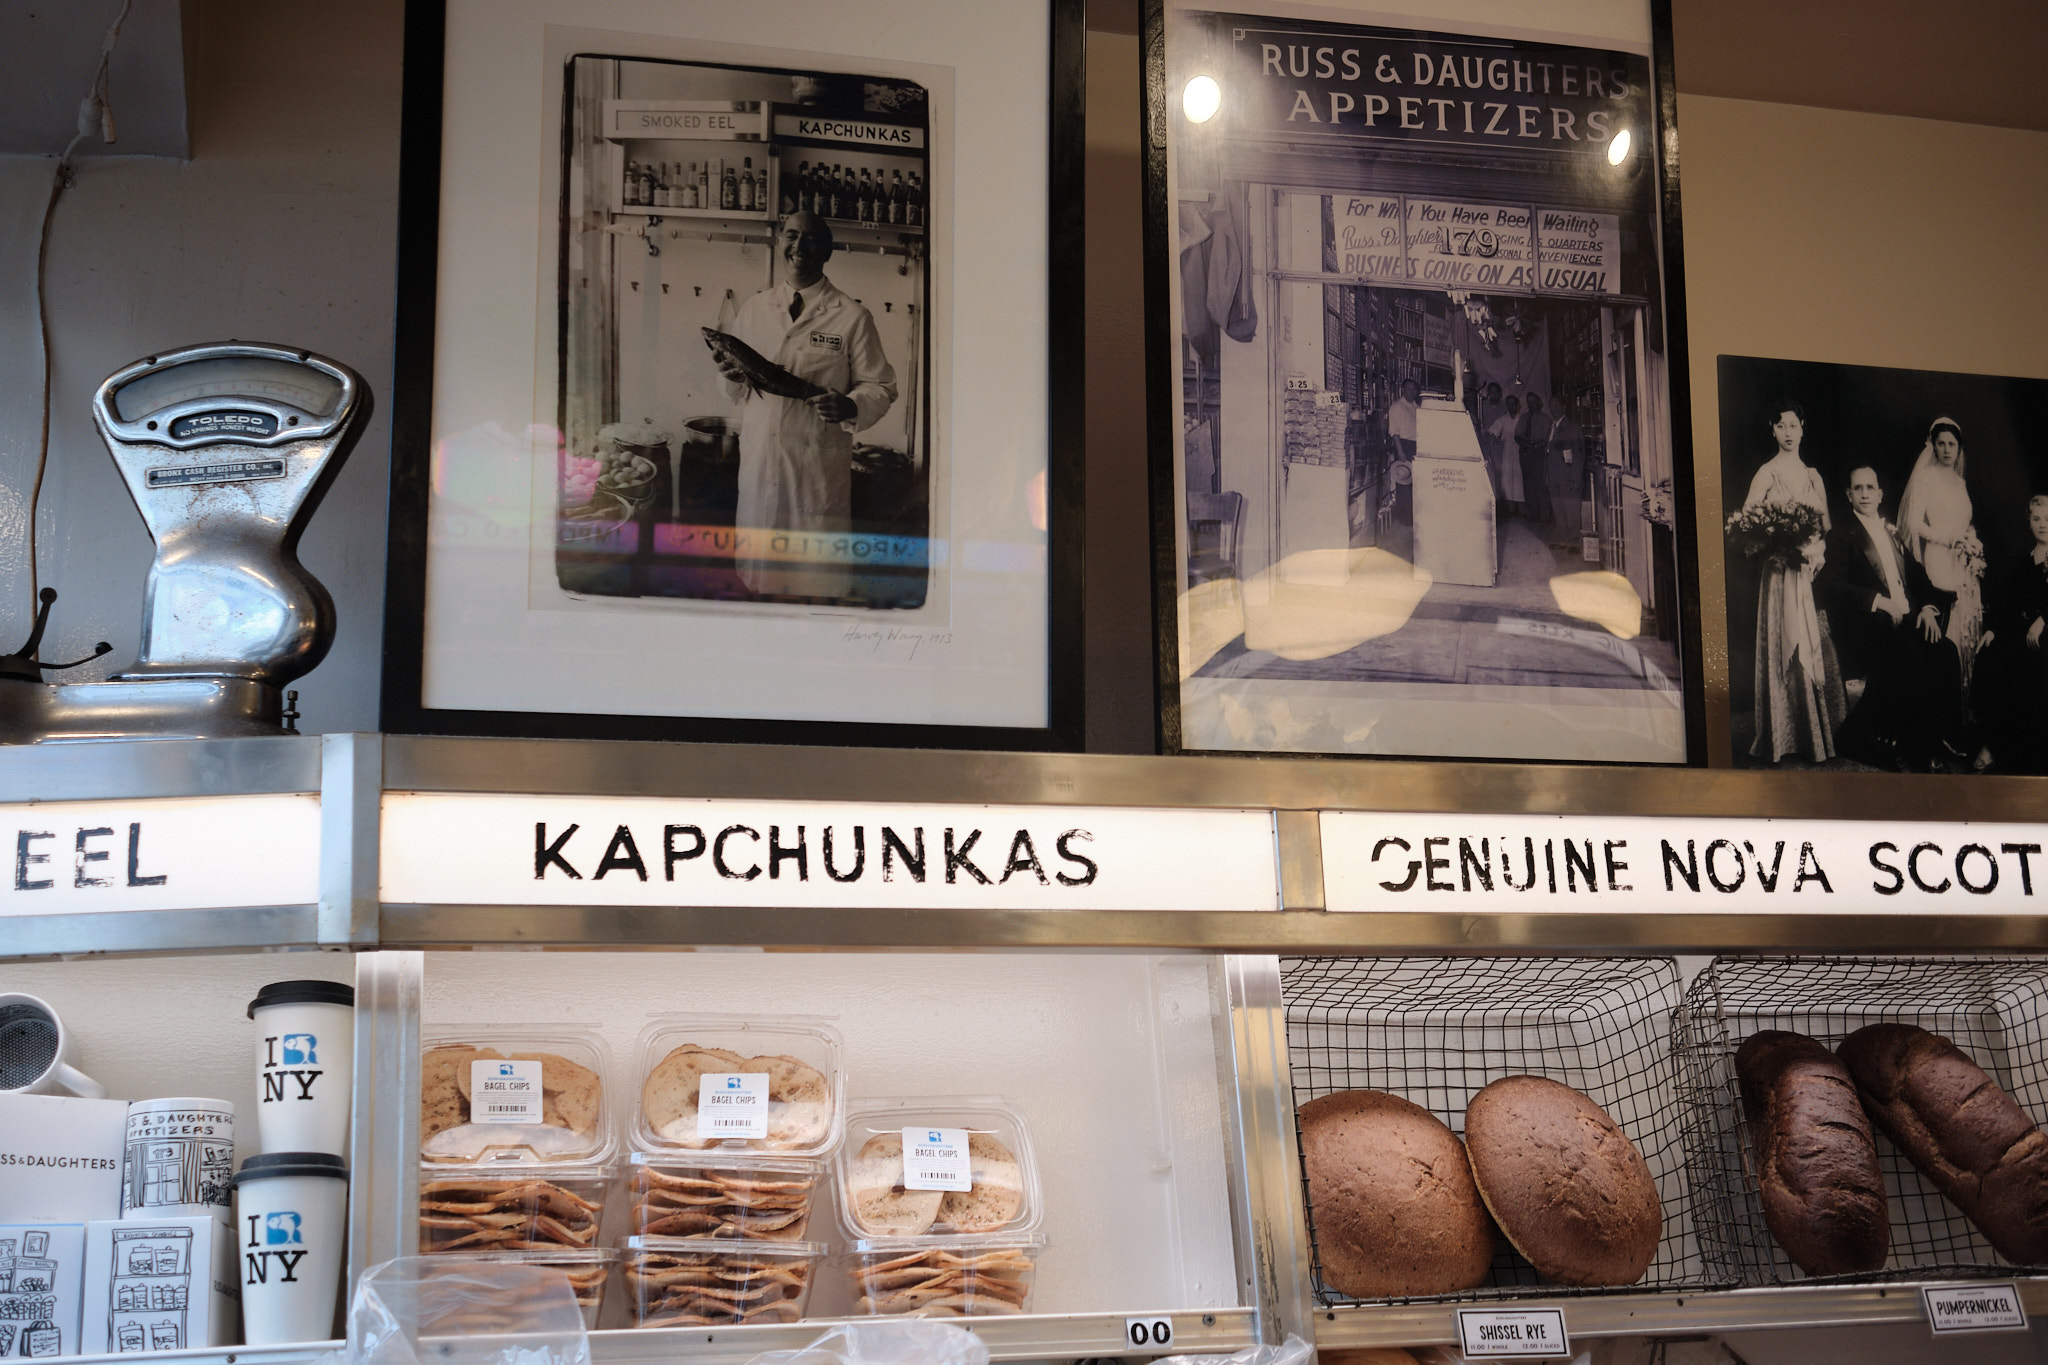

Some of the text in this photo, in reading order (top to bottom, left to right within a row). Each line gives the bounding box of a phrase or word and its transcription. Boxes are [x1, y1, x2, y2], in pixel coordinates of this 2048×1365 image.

[1261, 43, 1630, 100] RUSS & DAUGHTERS
[641, 115, 735, 129] SMOKED EEL
[1286, 90, 1611, 143] APPETIZERS
[799, 120, 911, 143] KAPCHUNKAS
[1347, 199, 1374, 216] For
[1378, 202, 1413, 219] Wht
[1420, 204, 1446, 221] You
[1452, 207, 1489, 226] Have
[1543, 214, 1599, 238] Waiting
[1342, 225, 1374, 250] Russ
[1548, 238, 1603, 251] QUARTERS
[1439, 227, 1498, 258] 179
[1527, 251, 1602, 264] CNVENIENCE
[1345, 254, 1607, 292] BUSINES GOING ON AS USUAL
[180, 429, 191, 437] NO
[192, 425, 218, 434] SPRINGS
[246, 425, 270, 435] WEIGHT
[188, 415, 264, 426] TOLEDO
[184, 467, 204, 476] CASH
[207, 465, 243, 474] REGISTER
[15, 822, 168, 891] EEL
[532, 822, 1099, 887] KAPCHUNKAS
[1371, 835, 2043, 897] GENUINE NOVA SCOT
[265, 1037, 278, 1068] I
[263, 1070, 323, 1103] NY
[484, 1082, 529, 1090] BAGEL CHIPS
[712, 1096, 755, 1104] BAGEL CHIPS
[915, 1149, 957, 1158] BAGEL CHIPS
[248, 1215, 260, 1247] I
[246, 1250, 308, 1285] NY
[1936, 1298, 2012, 1316] PUMPERNICKEL
[1131, 1321, 1170, 1345] 00
[1480, 1324, 1546, 1340] SHISSEL RYE
